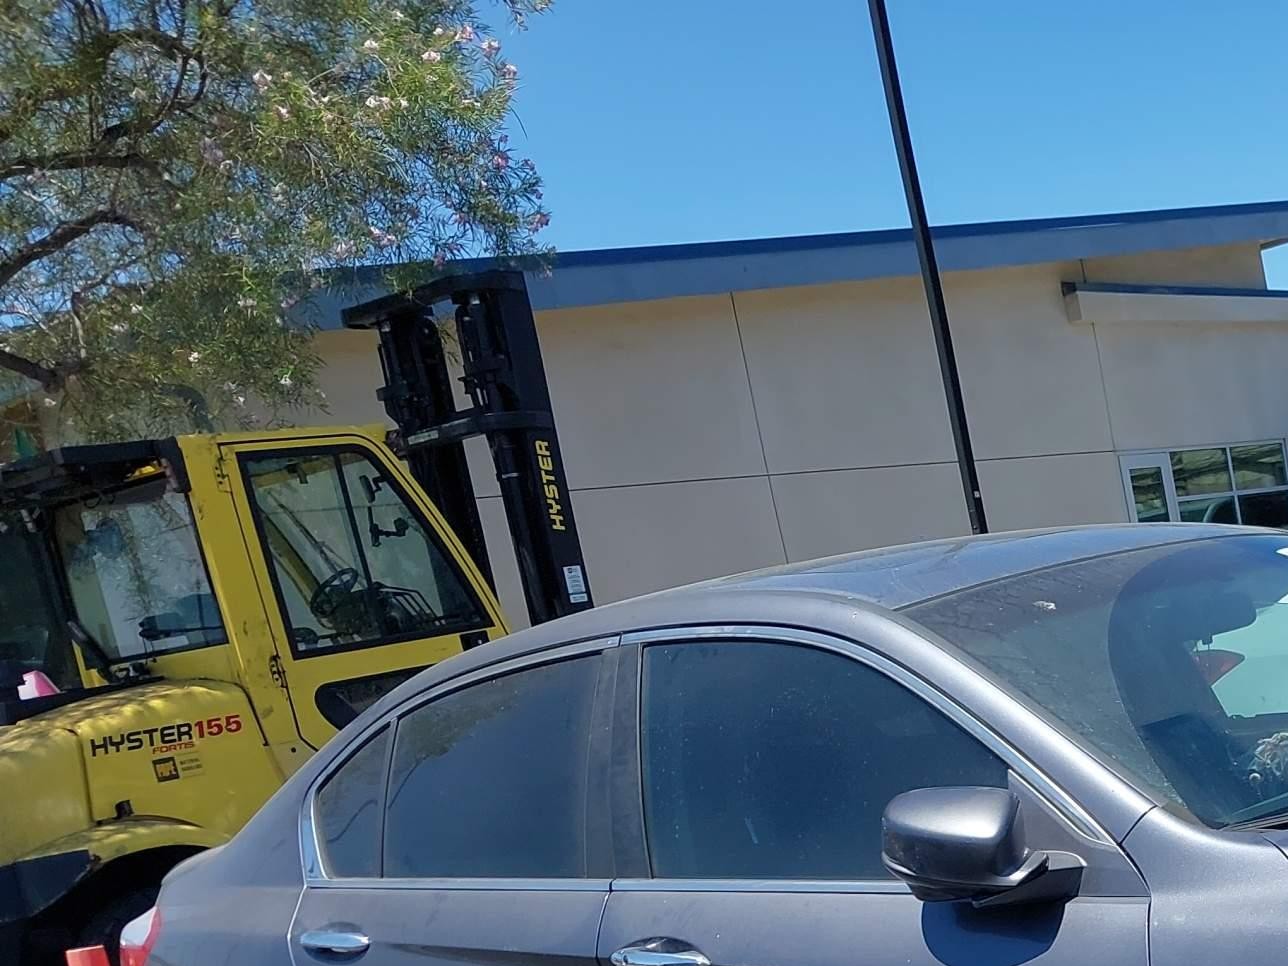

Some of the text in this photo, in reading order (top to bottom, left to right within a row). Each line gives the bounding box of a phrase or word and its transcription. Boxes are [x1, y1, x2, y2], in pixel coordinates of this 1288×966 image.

[534, 440, 566, 531] HYSTER
[90, 714, 242, 757] HYSTER 155
[152, 741, 195, 754] FORTIS
